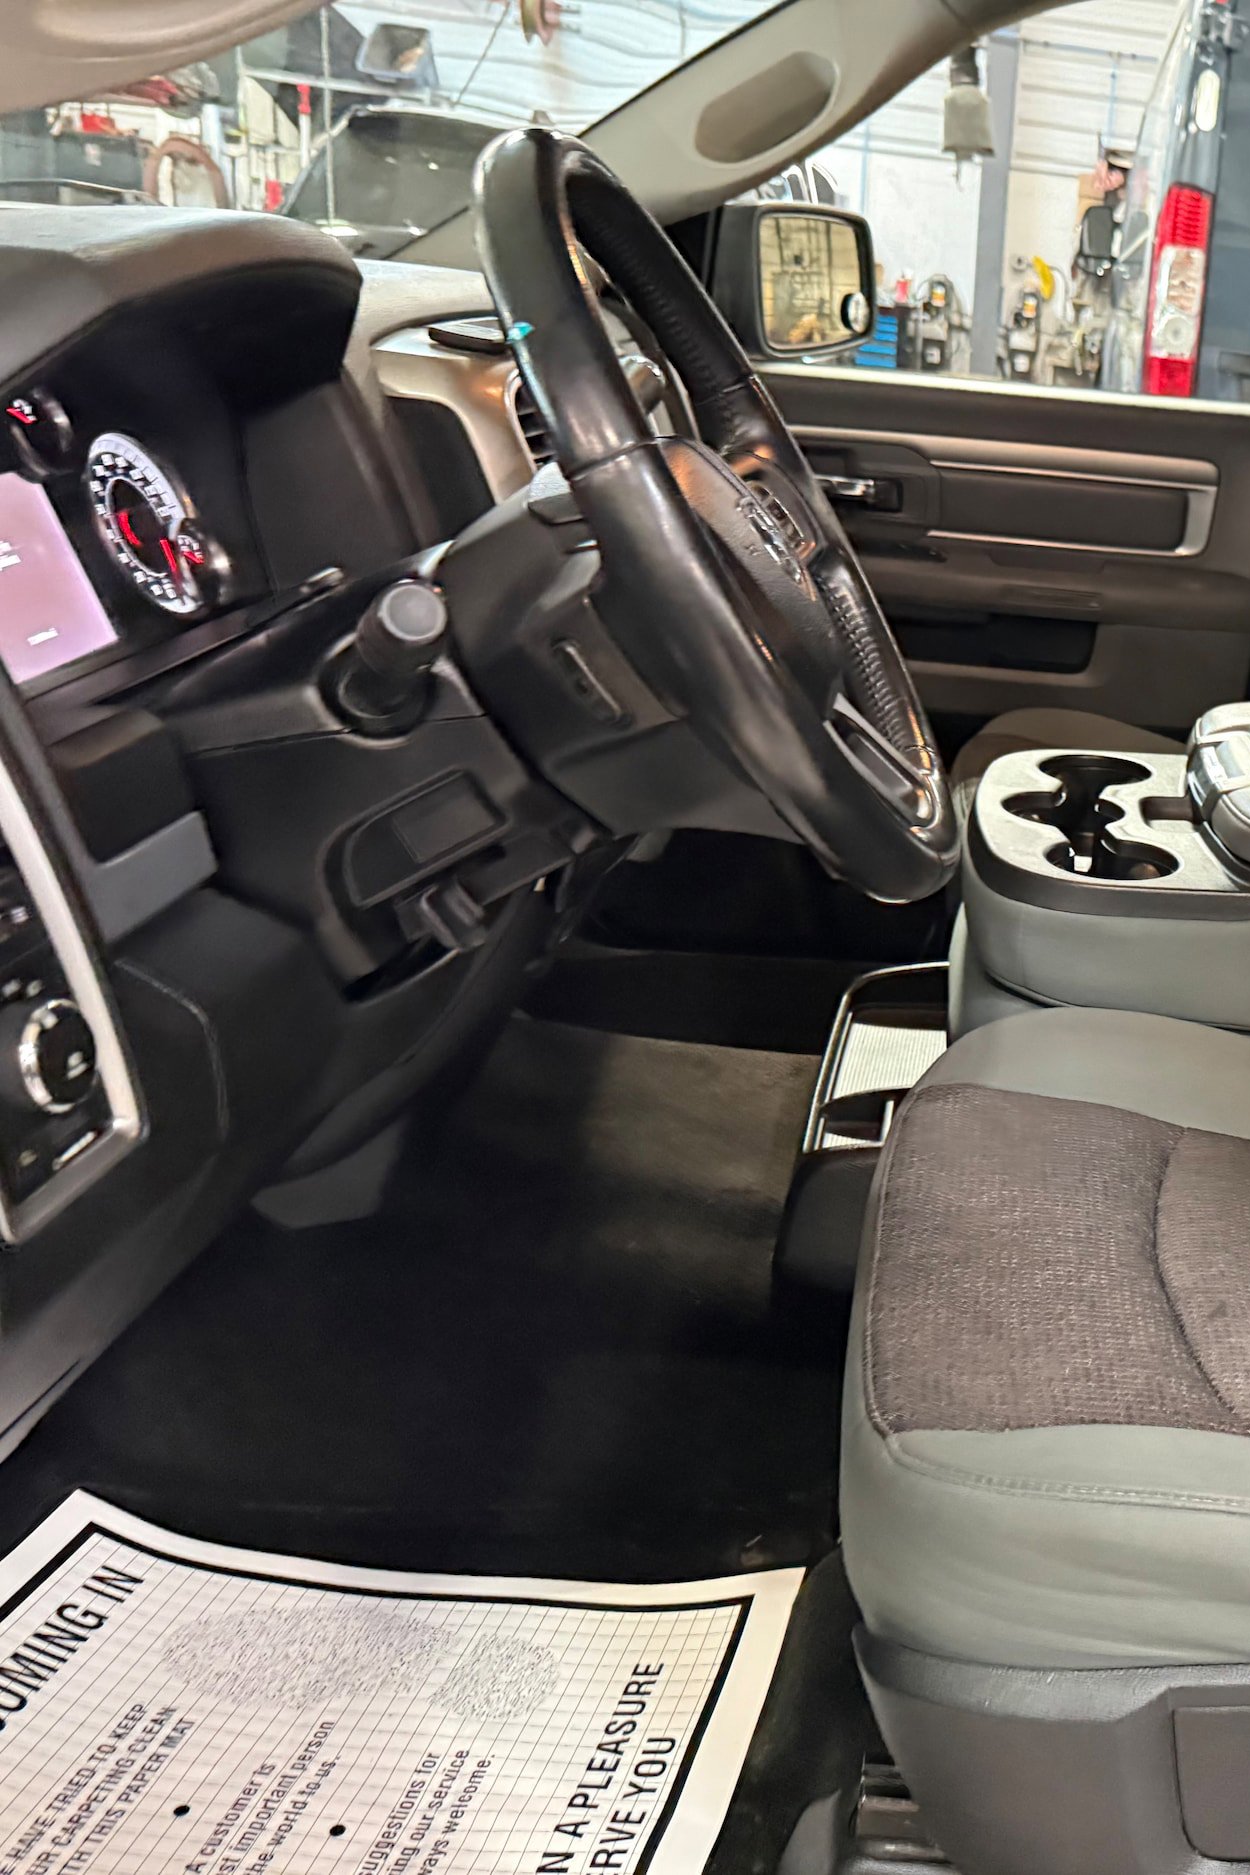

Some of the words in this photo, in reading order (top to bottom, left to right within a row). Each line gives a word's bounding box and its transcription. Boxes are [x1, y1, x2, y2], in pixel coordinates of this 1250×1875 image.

[82, 1565, 144, 1603] IN
[51, 1757, 136, 1847] CARPETING
[128, 1706, 178, 1753] CLEAN
[85, 1808, 126, 1845] THIS
[117, 1753, 169, 1804] PAPER
[160, 1717, 195, 1749] MAT
[414, 1752, 440, 1774] for
[566, 1662, 665, 1809] PLEASURE
[623, 1737, 677, 1799] YOU
[6, 1816, 56, 1861] HAVE
[45, 1768, 97, 1812] TRIED
[87, 1744, 118, 1763] TO
[108, 1704, 147, 1740] KEEP
[186, 1862, 208, 1874] A
[200, 1777, 262, 1856] customer
[253, 1762, 276, 1777] is
[229, 1774, 298, 1852] important
[291, 1721, 335, 1771] person
[267, 1800, 308, 1847] world
[298, 1782, 321, 1797] to
[411, 1814, 434, 1841] our
[428, 1750, 469, 1810] service
[442, 1754, 496, 1834] welcome.
[553, 1820, 591, 1838] A
